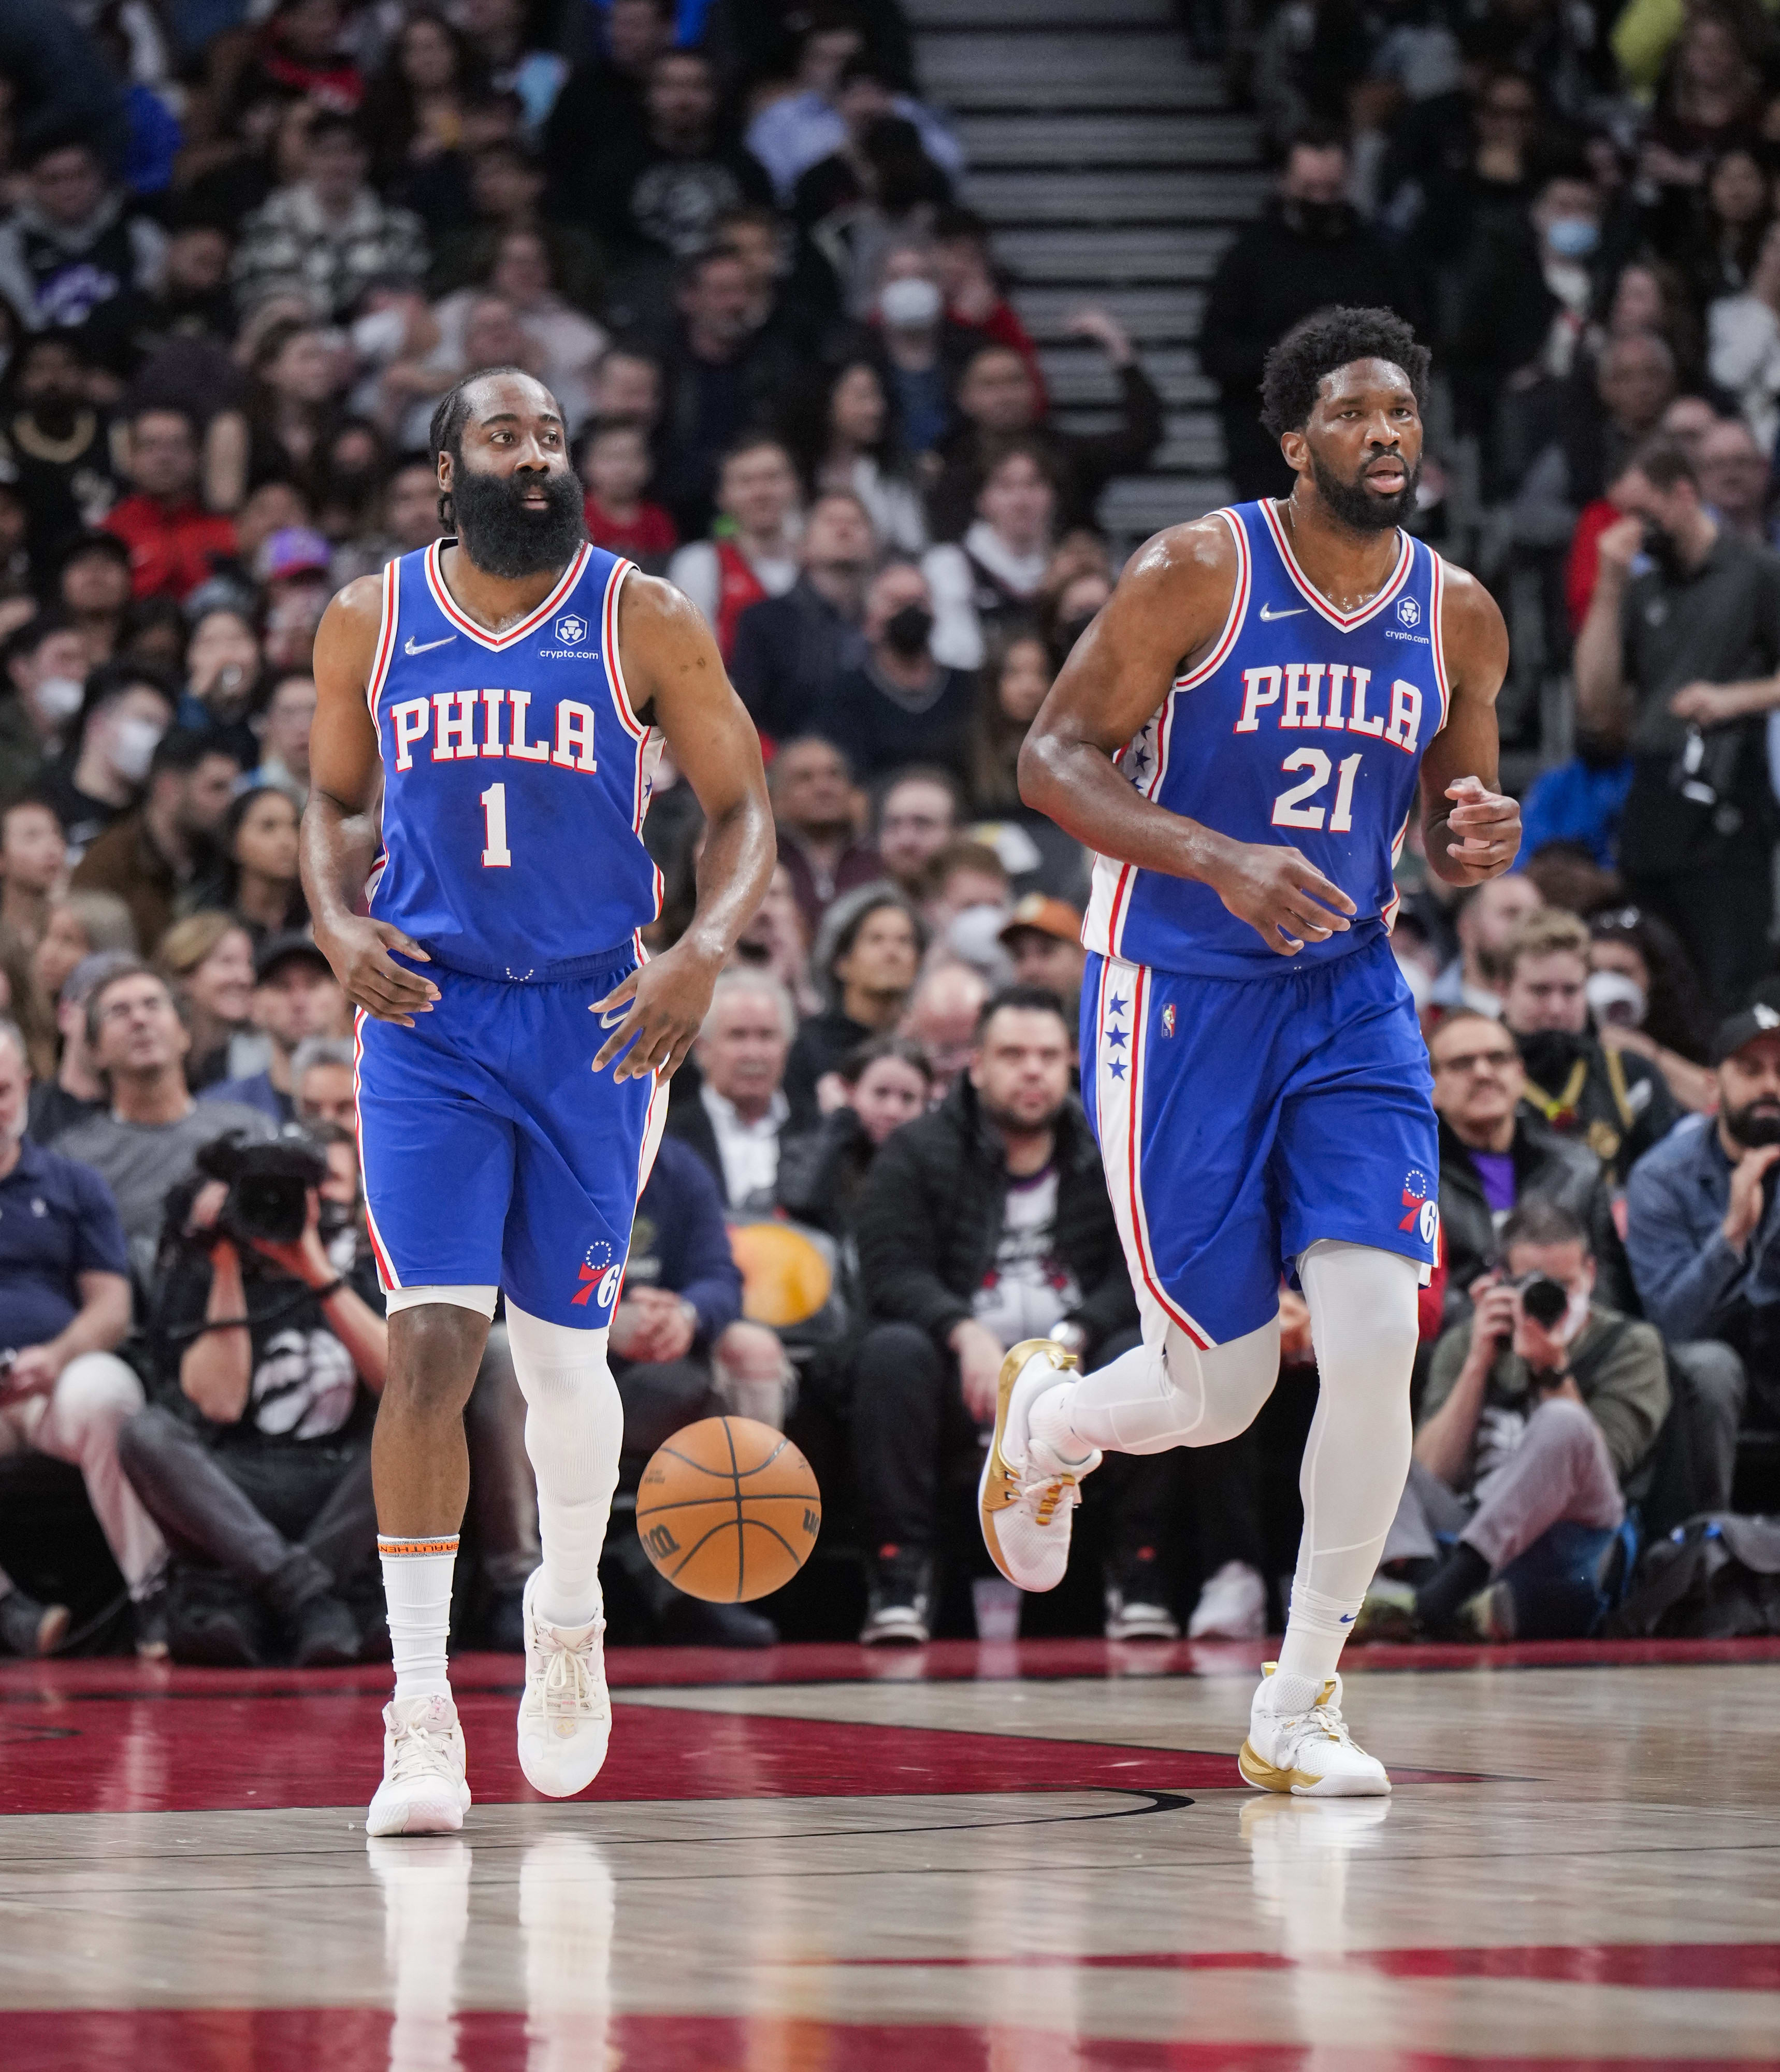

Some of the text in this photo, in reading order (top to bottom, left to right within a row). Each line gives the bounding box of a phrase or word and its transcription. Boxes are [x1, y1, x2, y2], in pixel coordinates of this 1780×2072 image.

[540, 648, 599, 660] crypto.com
[1385, 629, 1429, 645] crypto.com
[390, 688, 598, 775] PHILA
[1234, 664, 1422, 755] PHILA
[1271, 747, 1363, 833] 21
[480, 783, 512, 868] 1
[1398, 1188, 1437, 1244] 76
[571, 1262, 620, 1308] 76
[379, 1544, 443, 1552] AUTHEN
